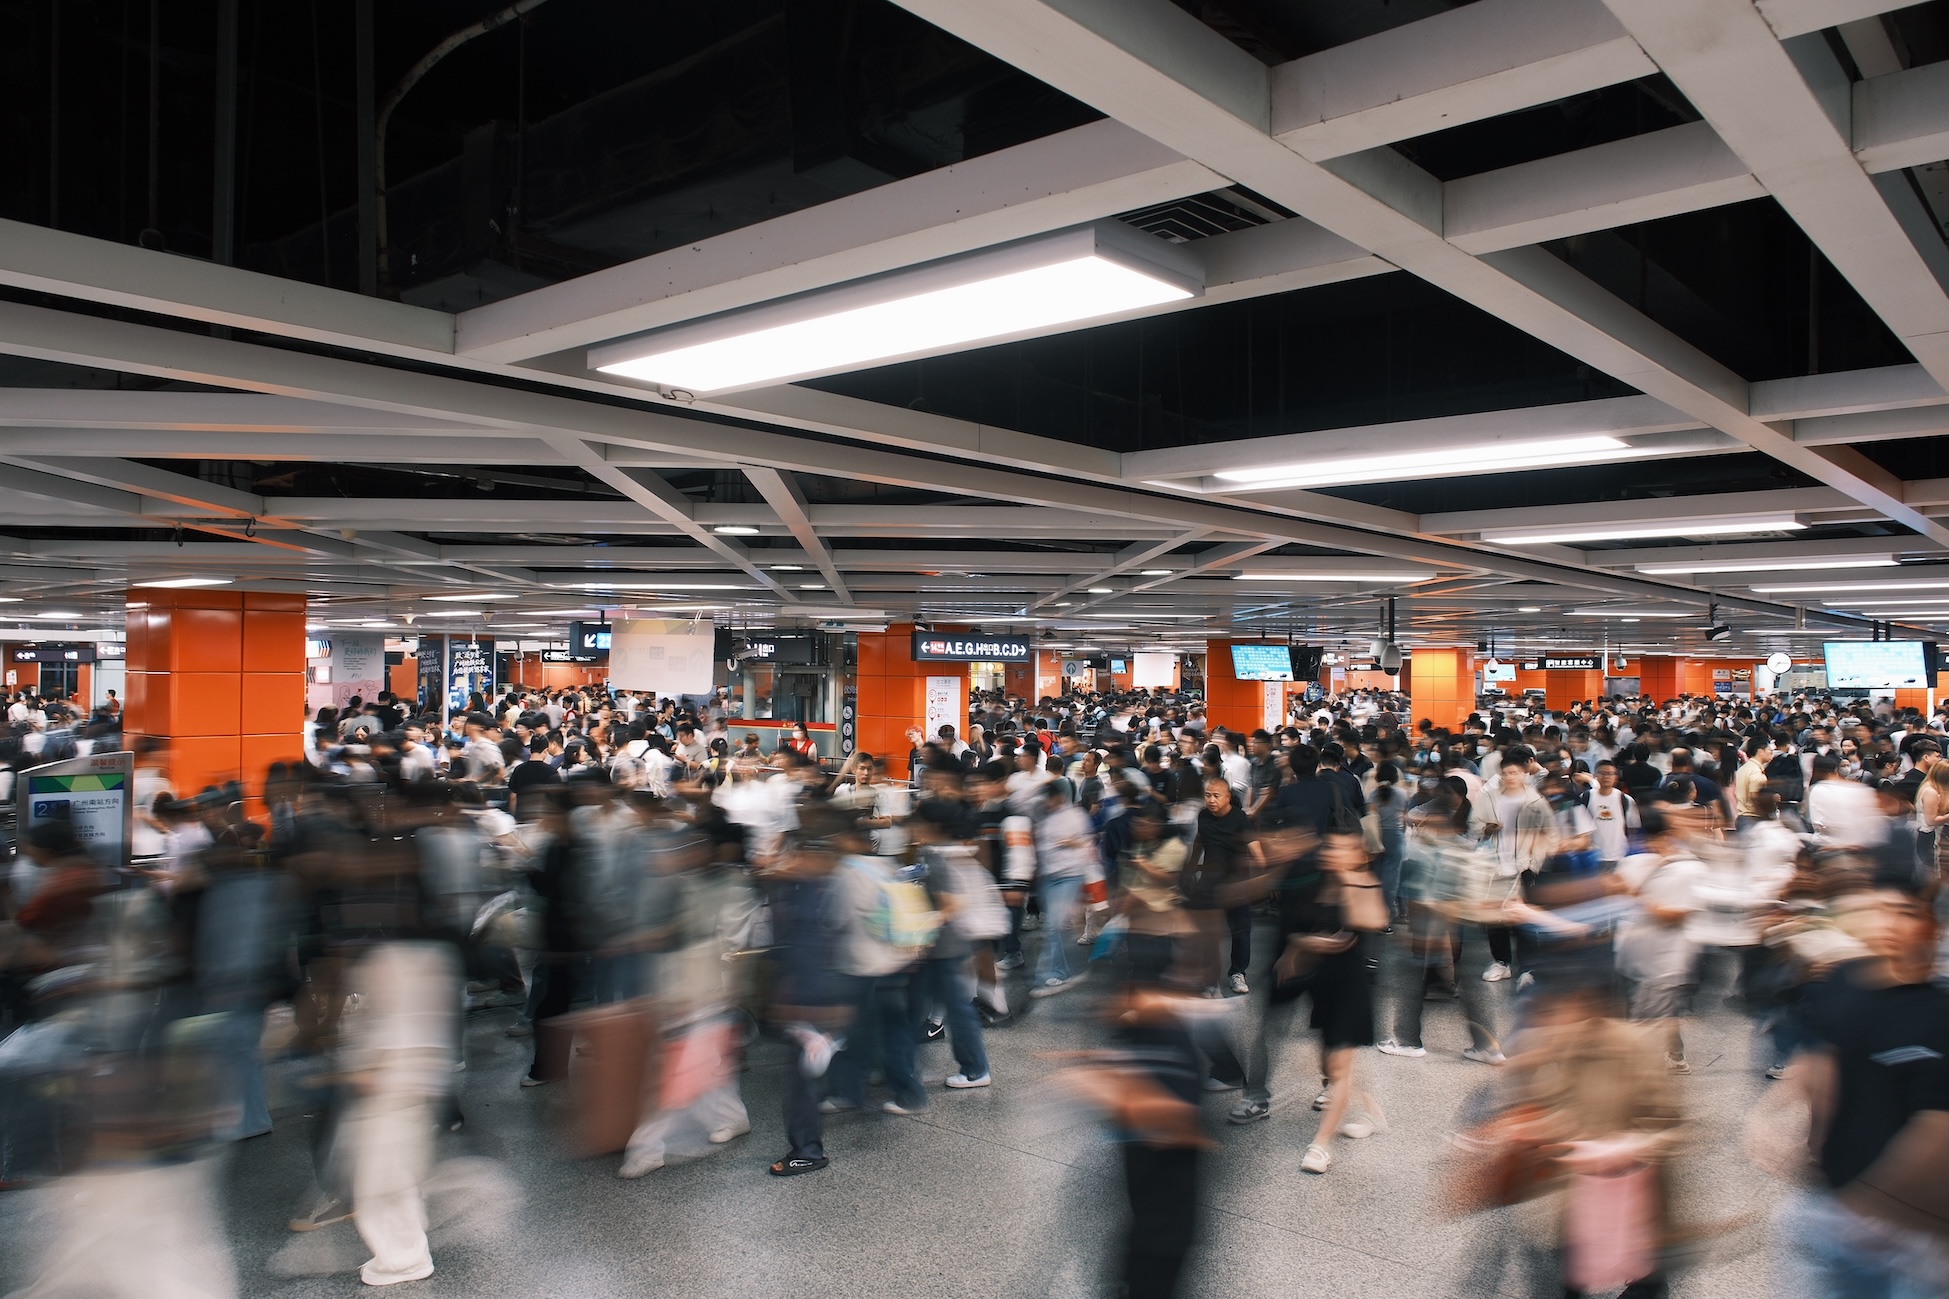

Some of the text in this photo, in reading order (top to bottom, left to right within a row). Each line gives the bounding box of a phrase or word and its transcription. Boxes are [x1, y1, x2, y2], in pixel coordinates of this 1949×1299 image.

[73, 798, 120, 807] 广州南站方向
[37, 803, 48, 816] 2
